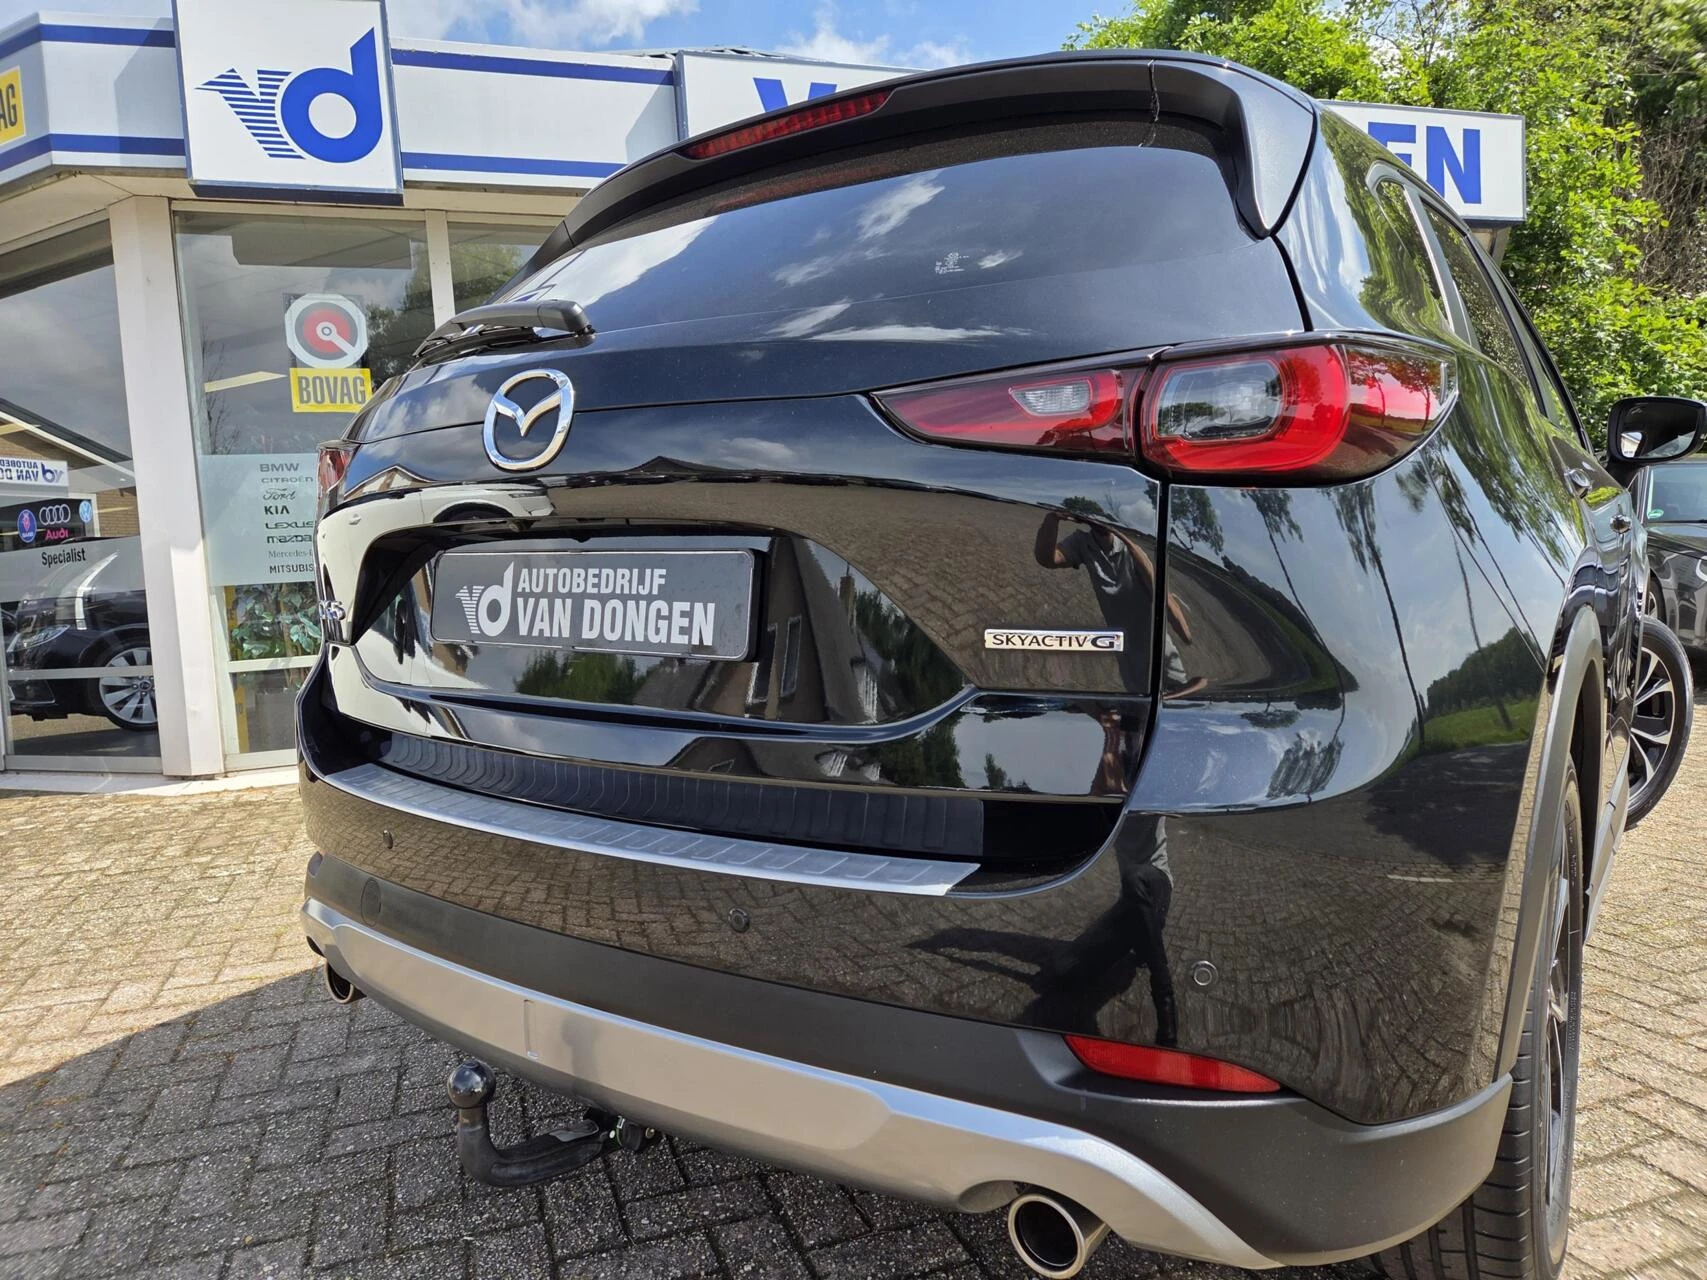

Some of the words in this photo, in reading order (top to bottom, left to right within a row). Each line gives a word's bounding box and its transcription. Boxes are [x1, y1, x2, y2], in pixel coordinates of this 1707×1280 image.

[298, 375, 366, 405] BOVAG
[260, 463, 299, 472] BMW
[263, 488, 296, 500] Ford
[264, 505, 290, 515] KIA
[45, 528, 69, 540] Audi
[41, 547, 86, 568] Specialist
[517, 568, 667, 595] AUTOBEDRIJF
[516, 597, 573, 638] VAN
[581, 599, 716, 646] DONGEN
